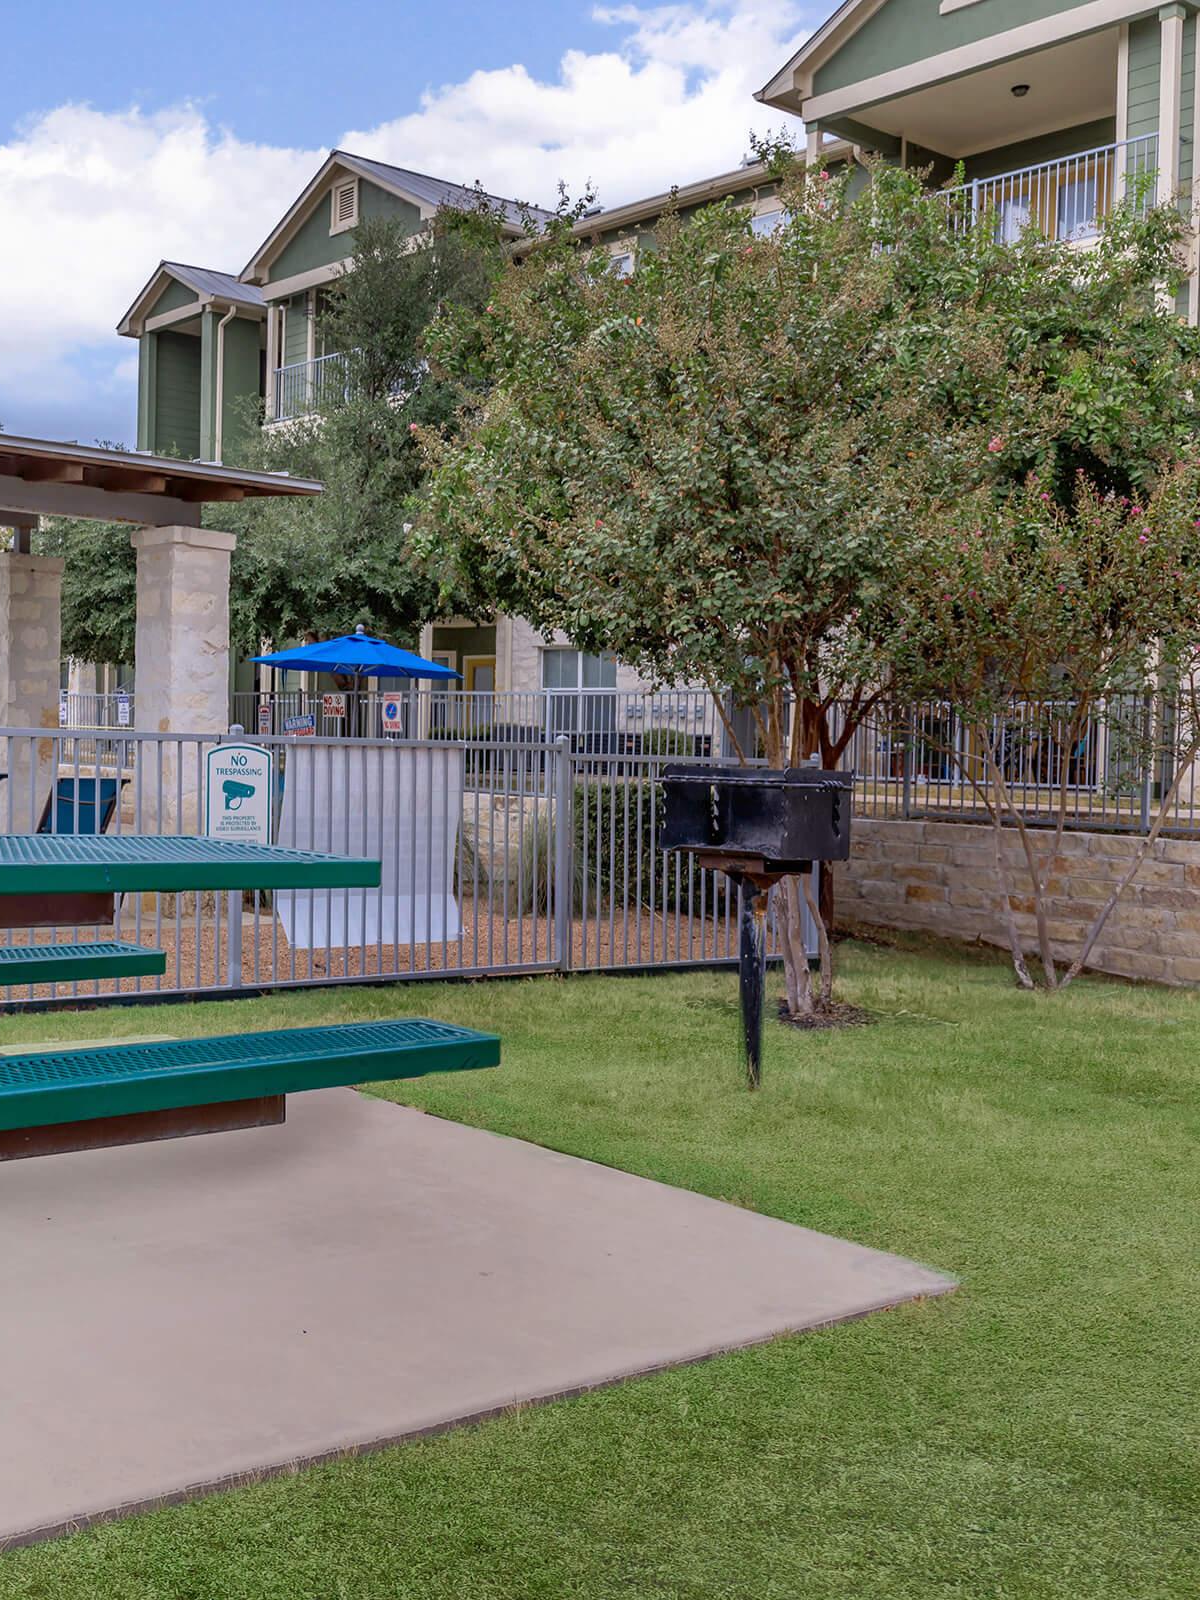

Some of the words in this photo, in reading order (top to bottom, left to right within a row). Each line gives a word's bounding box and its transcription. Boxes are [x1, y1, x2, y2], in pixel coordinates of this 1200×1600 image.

[324, 695, 333, 704] NO
[323, 705, 345, 715] DIVING
[231, 755, 248, 766] NO
[216, 767, 262, 776] TRESPASSING
